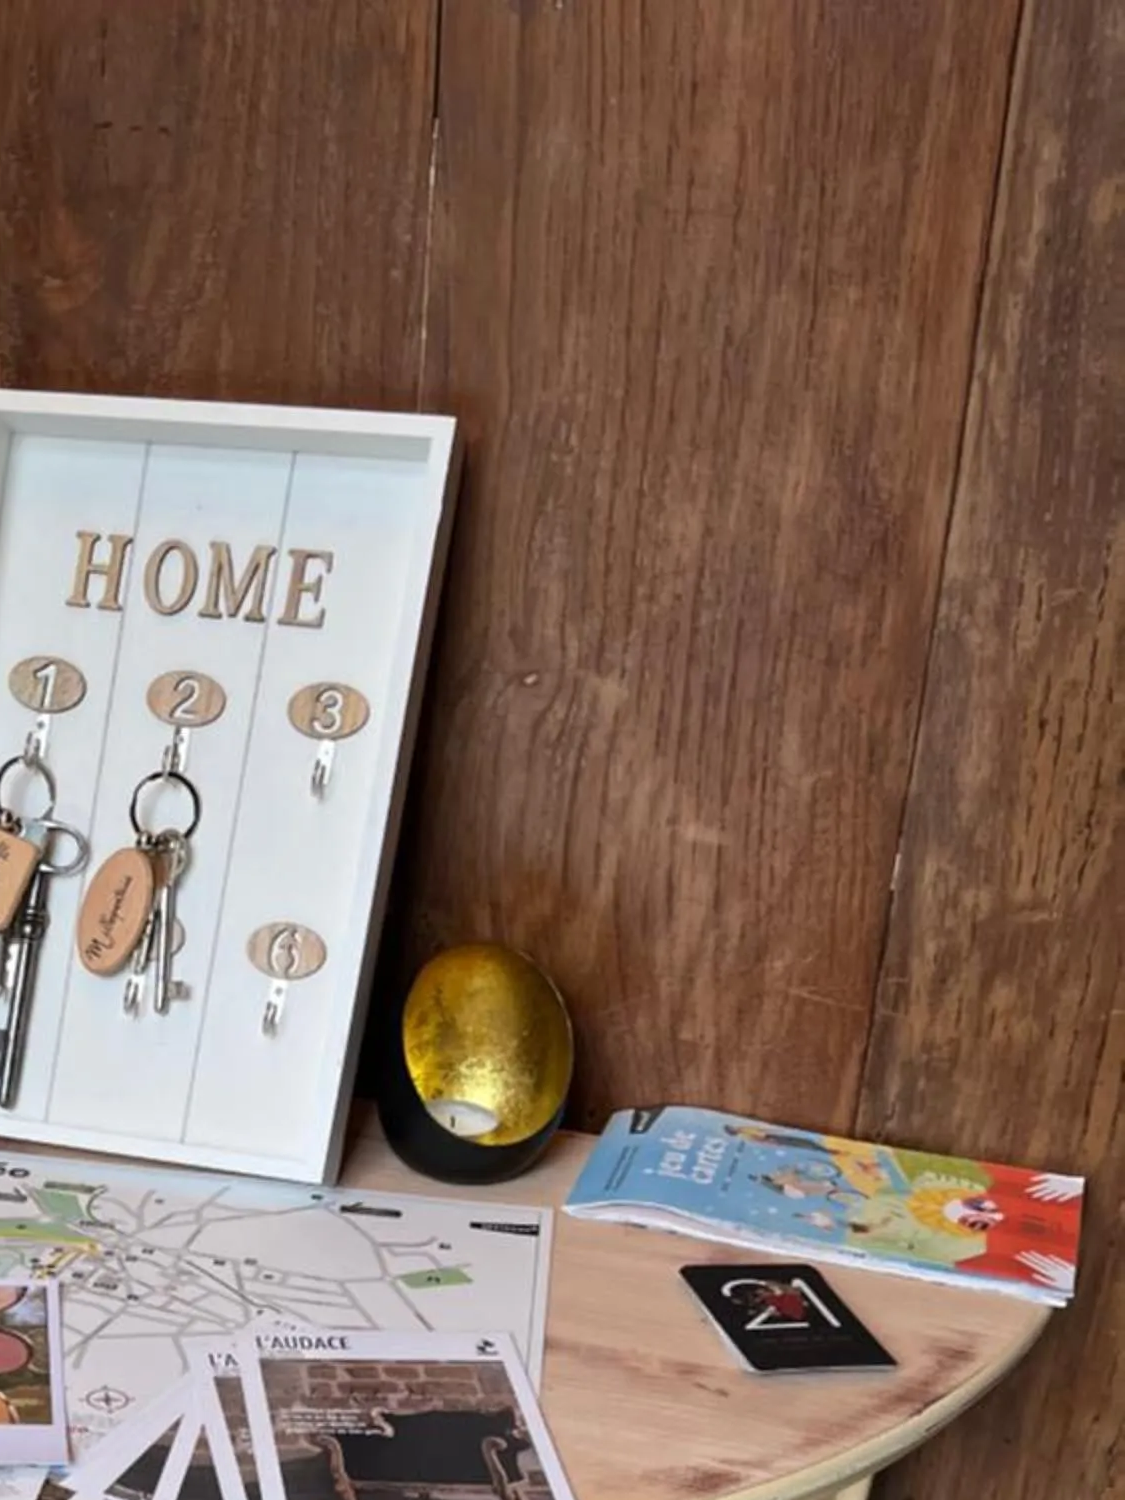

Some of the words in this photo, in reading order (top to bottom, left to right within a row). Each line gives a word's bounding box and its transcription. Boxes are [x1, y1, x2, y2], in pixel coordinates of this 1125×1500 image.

[64, 529, 335, 629] HOME
[32, 660, 60, 710] 1
[171, 674, 202, 721] 2
[311, 685, 348, 736] 3
[721, 1278, 841, 1331] 21
[255, 1335, 351, 1351] L'AUDACE
